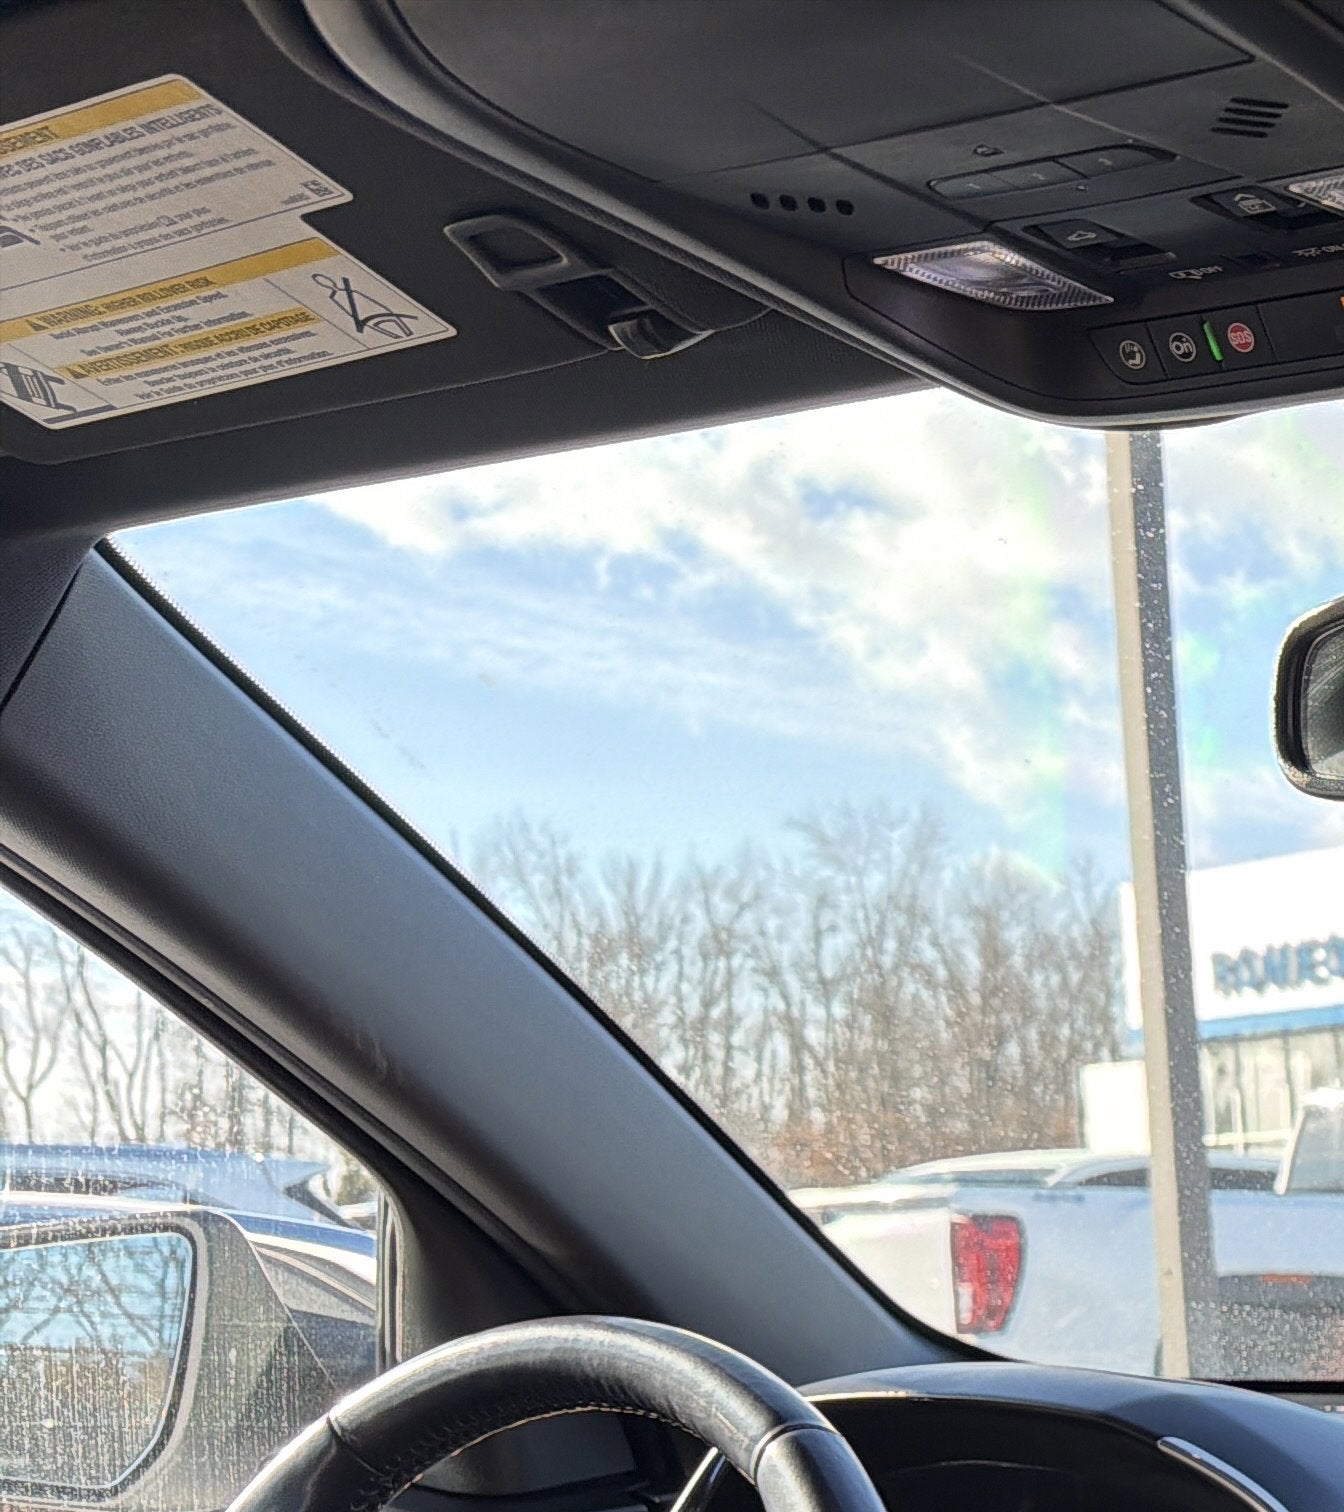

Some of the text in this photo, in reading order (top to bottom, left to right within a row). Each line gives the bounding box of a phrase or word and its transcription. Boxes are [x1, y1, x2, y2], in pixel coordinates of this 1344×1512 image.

[38, 148, 76, 165] SACS
[1170, 337, 1193, 355] On
[1230, 330, 1254, 346] SOS
